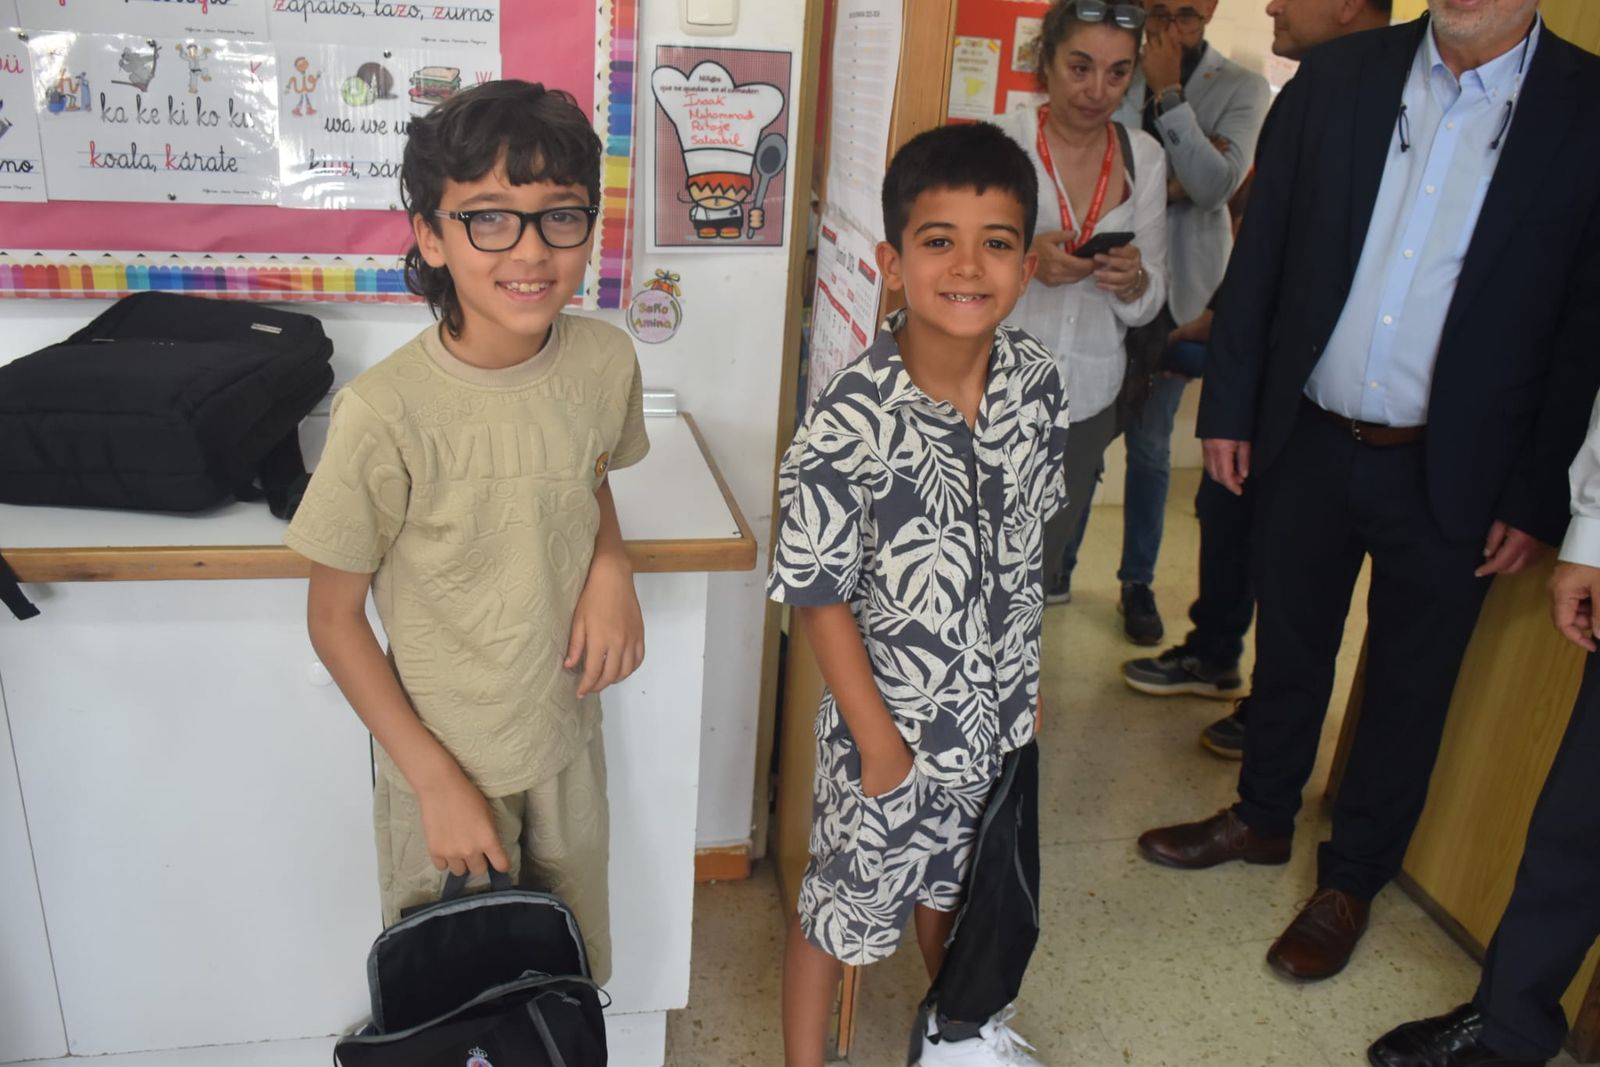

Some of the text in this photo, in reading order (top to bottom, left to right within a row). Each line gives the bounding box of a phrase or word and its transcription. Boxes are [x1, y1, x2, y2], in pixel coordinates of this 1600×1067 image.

[374, 0, 424, 21] lazo,
[432, 5, 494, 22] zumo
[100, 92, 129, 123] ka
[136, 93, 160, 125] ke
[168, 94, 189, 126] ki
[196, 96, 221, 127] ko
[324, 117, 355, 133] wa
[361, 119, 388, 135] we
[90, 140, 239, 173] koala, kárate
